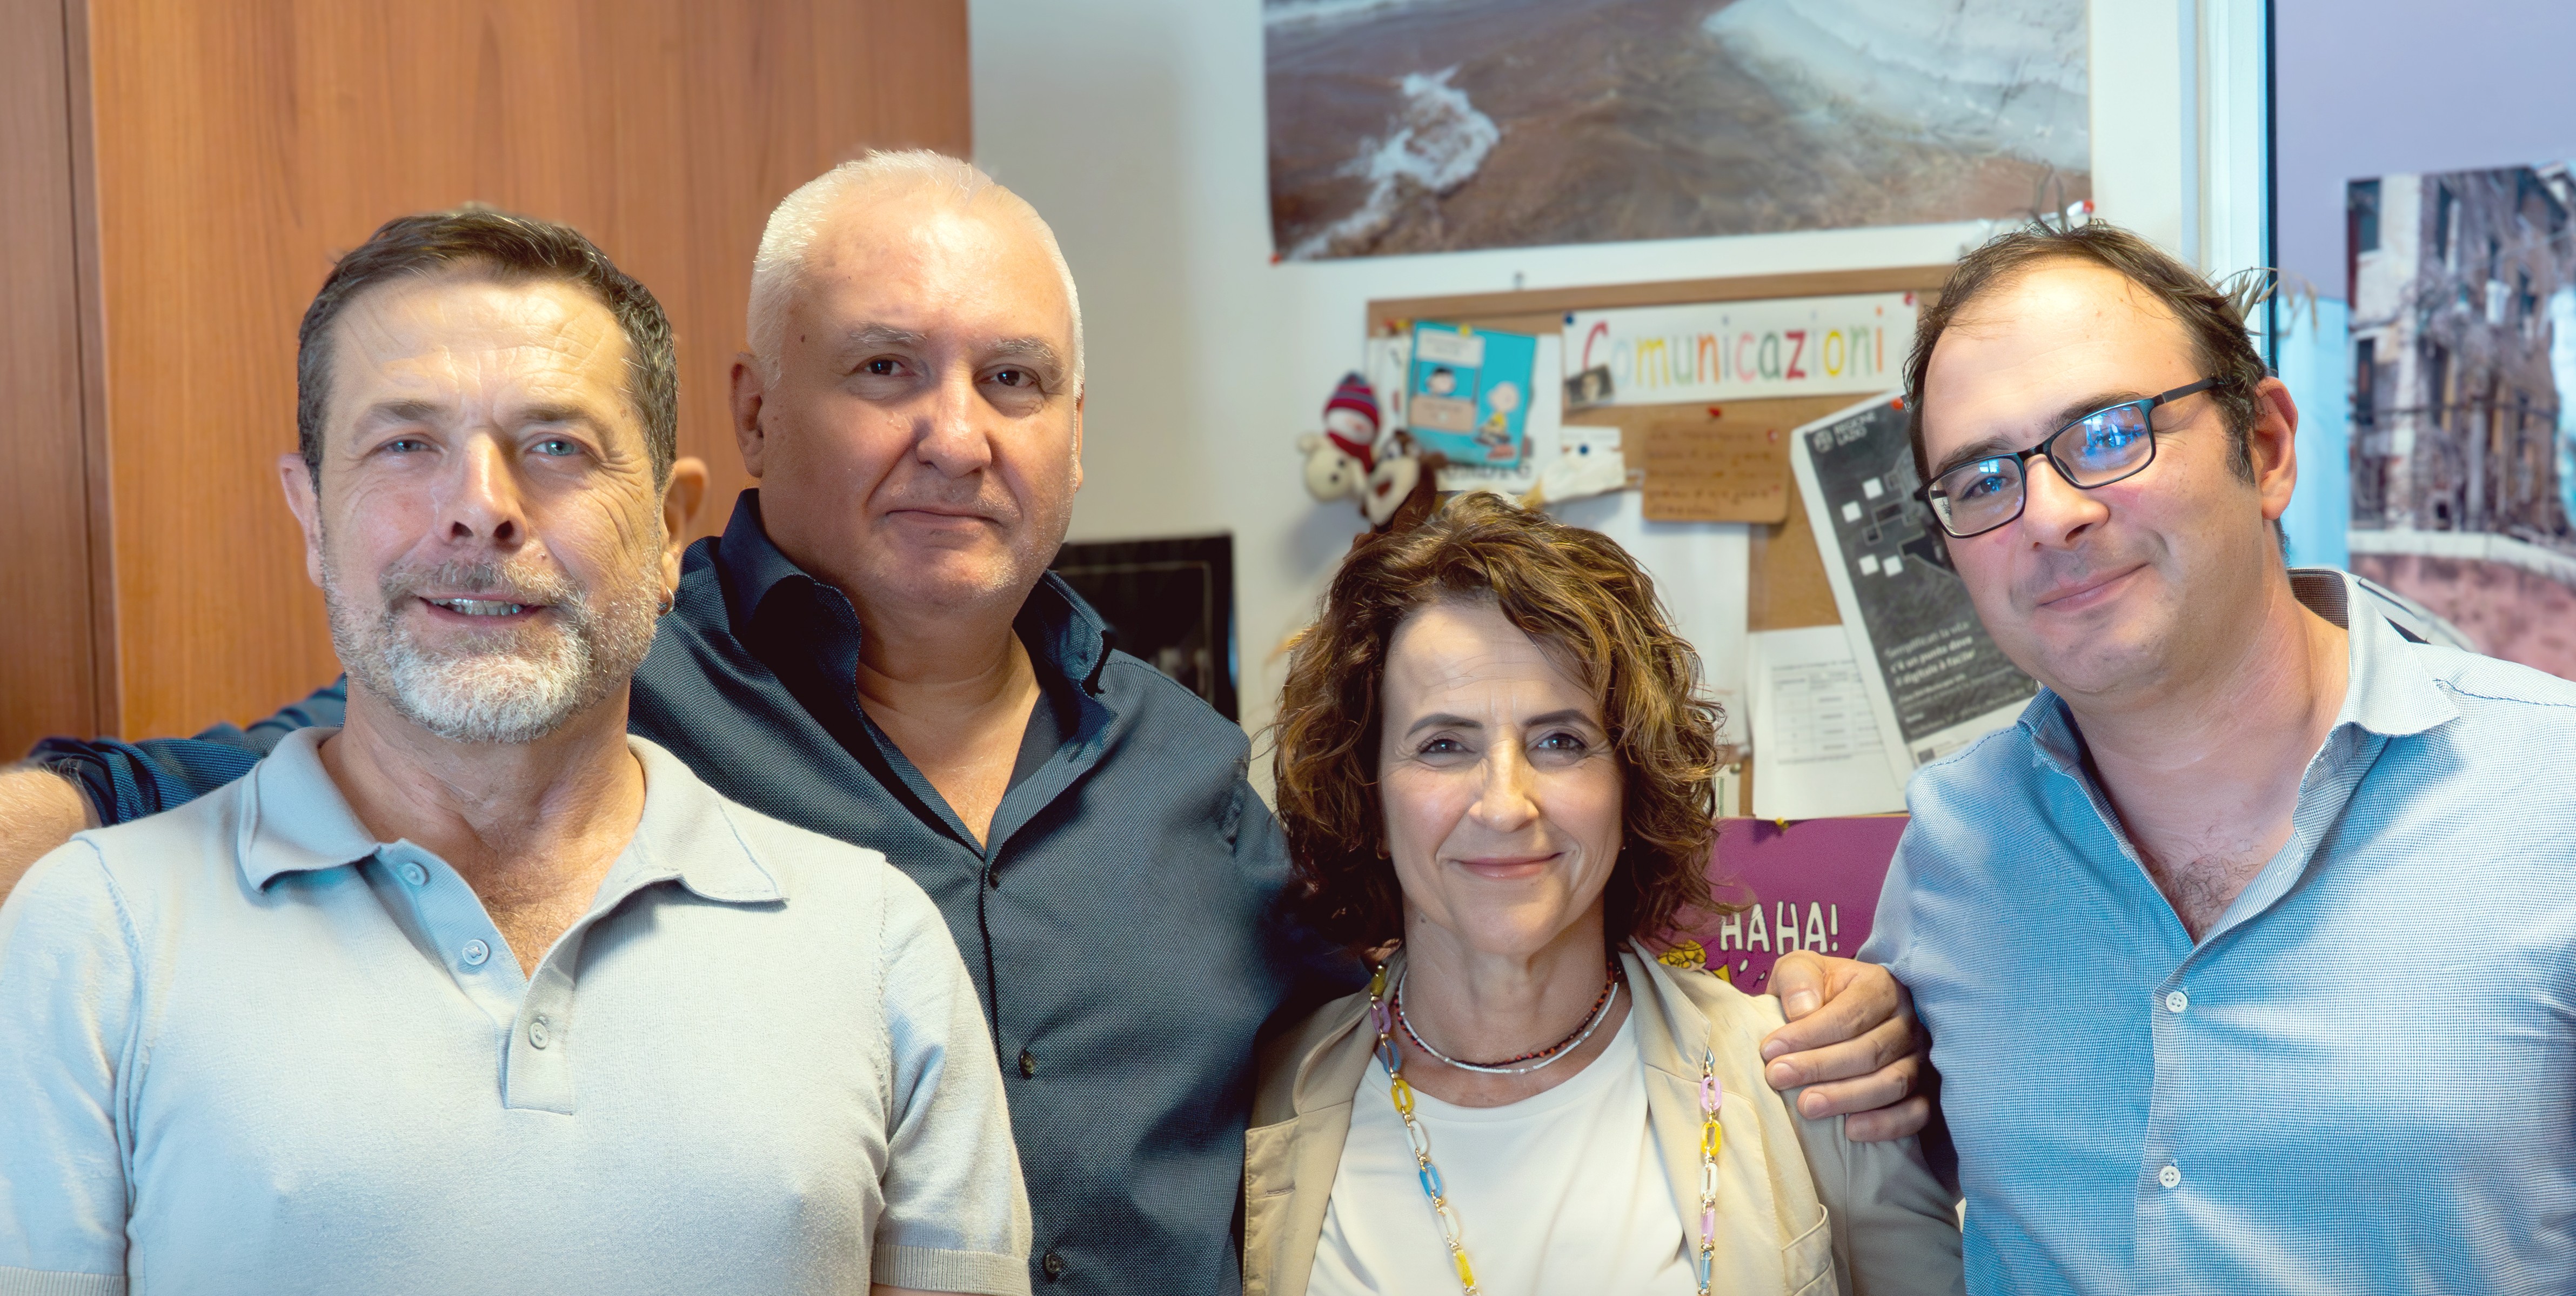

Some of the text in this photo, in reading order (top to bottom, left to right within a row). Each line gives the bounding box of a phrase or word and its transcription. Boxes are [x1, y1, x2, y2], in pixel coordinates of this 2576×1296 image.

[1582, 305, 1883, 388] Comunicazioni
[1834, 411, 1877, 435] REGIONE
[1836, 426, 1868, 446] LAZIO
[1905, 656, 1919, 669] un
[1919, 645, 1948, 666] punto
[1948, 636, 1973, 652] dove
[1903, 663, 1938, 684] digitale
